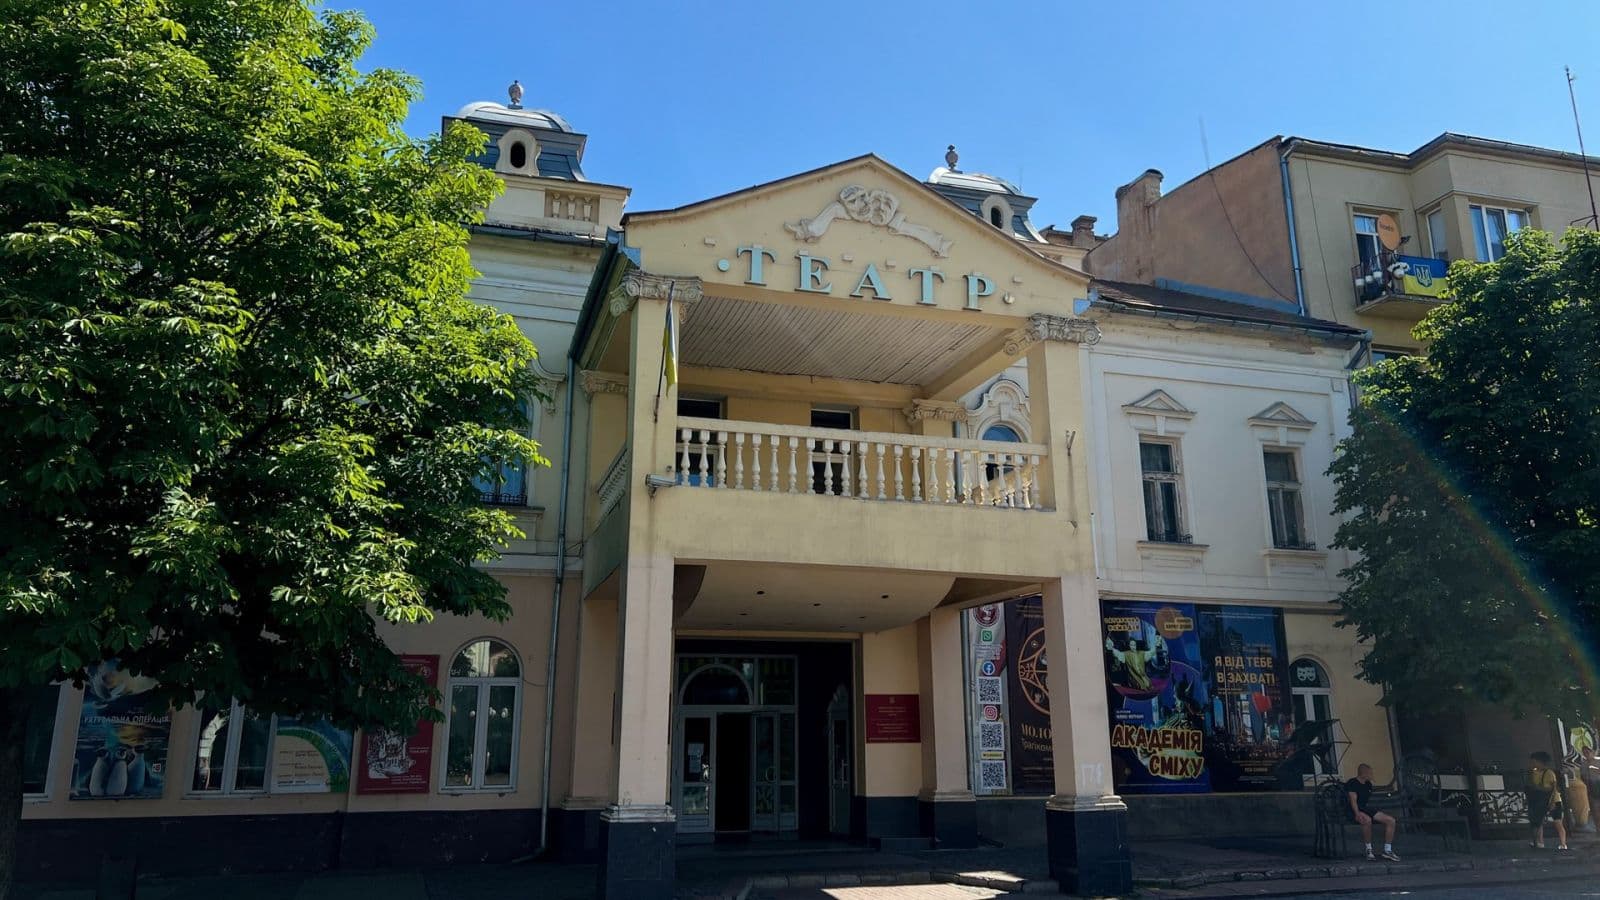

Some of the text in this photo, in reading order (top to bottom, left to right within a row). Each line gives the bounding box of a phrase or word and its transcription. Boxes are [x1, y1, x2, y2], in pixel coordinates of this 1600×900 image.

[736, 244, 995, 311] ТЕАТР
[1214, 655, 1273, 670] Я ВІД ТЕБЕ
[1217, 672, 1275, 685] В ЗАХВАТІ
[1021, 723, 1053, 739] МОЛО
[1112, 724, 1202, 752] АКАДЕМІЯ
[1149, 755, 1204, 778] СМІХУ
